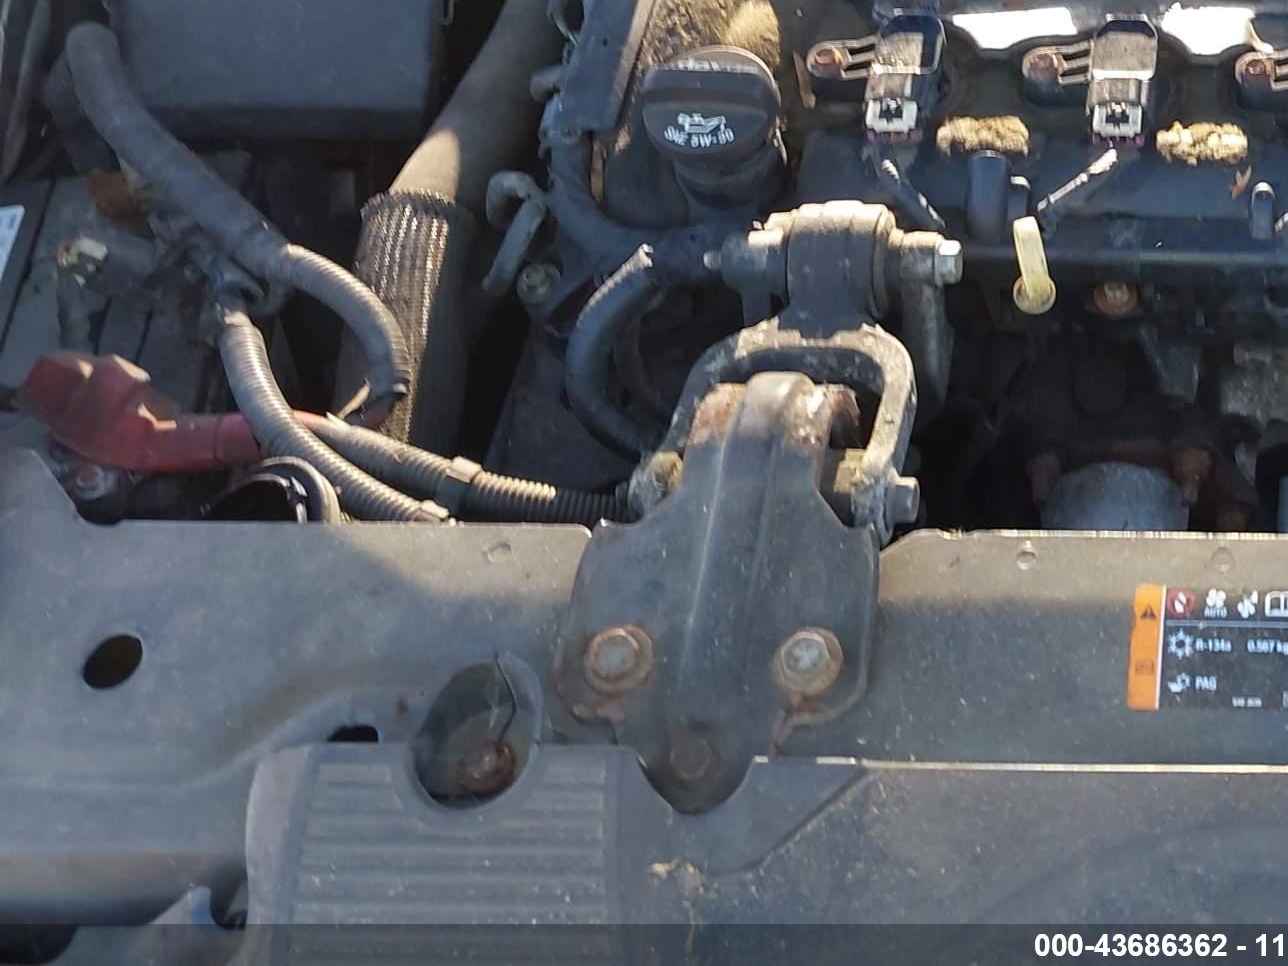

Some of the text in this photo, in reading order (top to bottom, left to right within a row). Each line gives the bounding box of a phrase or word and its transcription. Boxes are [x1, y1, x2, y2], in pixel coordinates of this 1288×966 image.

[1204, 605, 1228, 618] AUTO
[1195, 637, 1232, 652] R-134a
[1195, 675, 1217, 691] PAG
